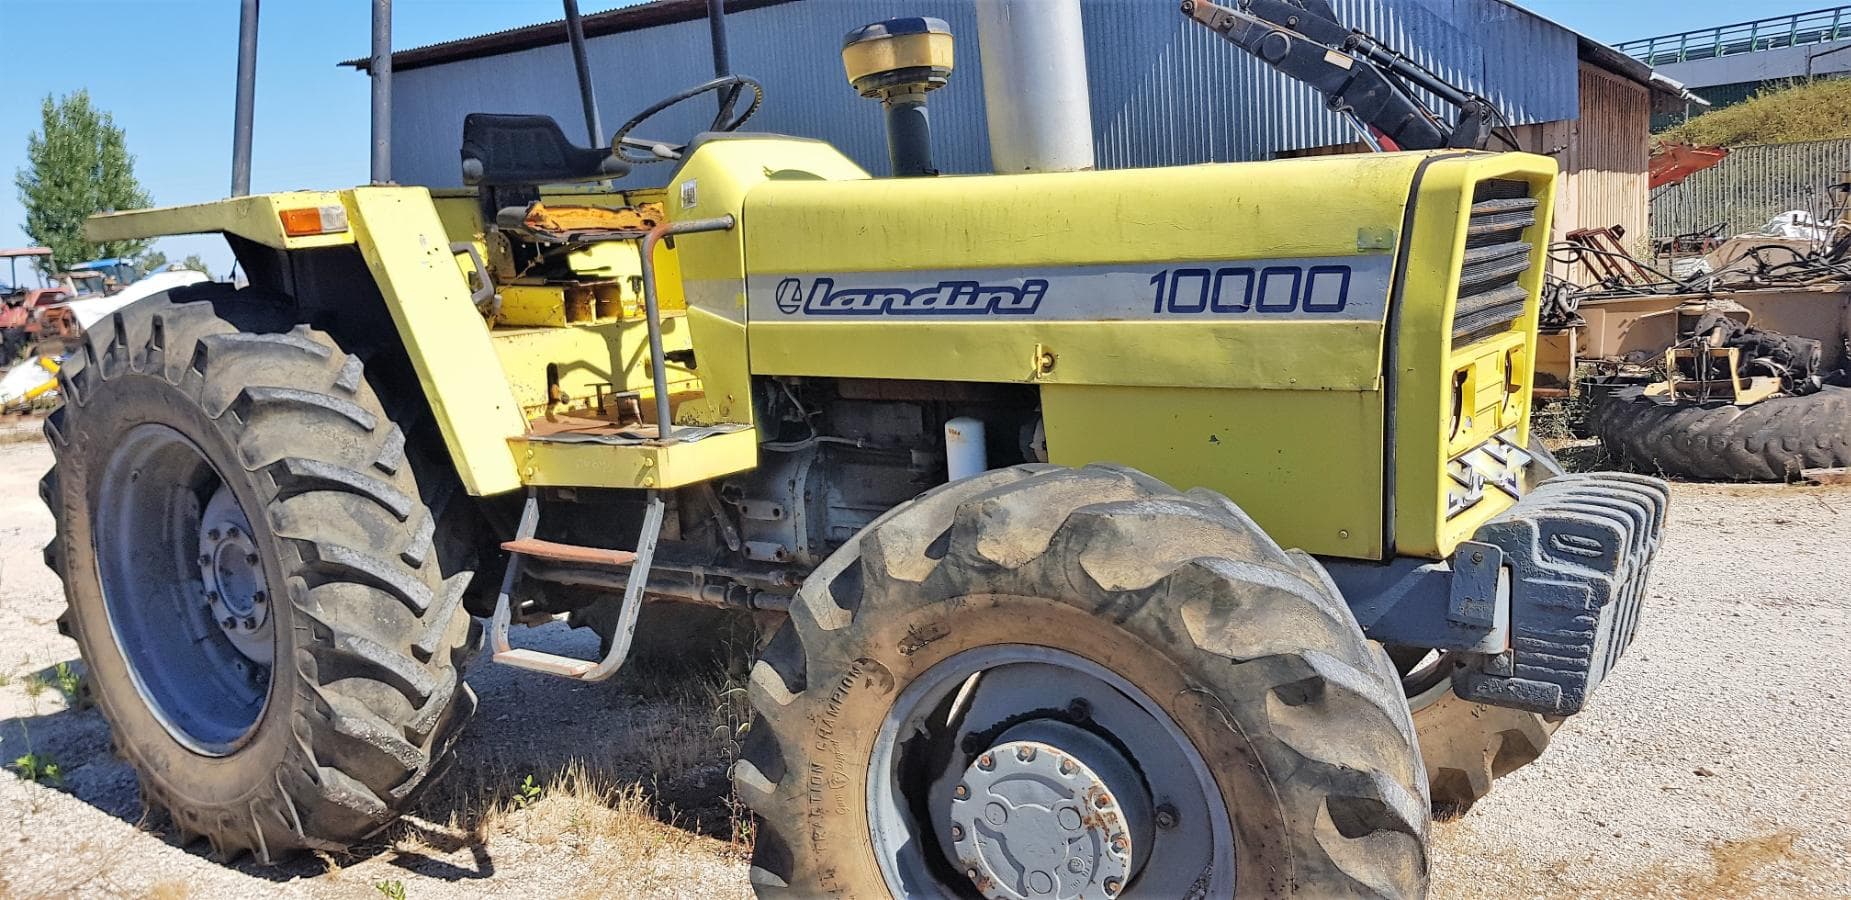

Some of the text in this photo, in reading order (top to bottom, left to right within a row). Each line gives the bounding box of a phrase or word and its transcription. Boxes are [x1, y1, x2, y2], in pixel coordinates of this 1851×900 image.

[803, 277, 1049, 315] Landini
[1150, 265, 1352, 314] 10000
[808, 662, 863, 856] TRACTION CHAMPION
